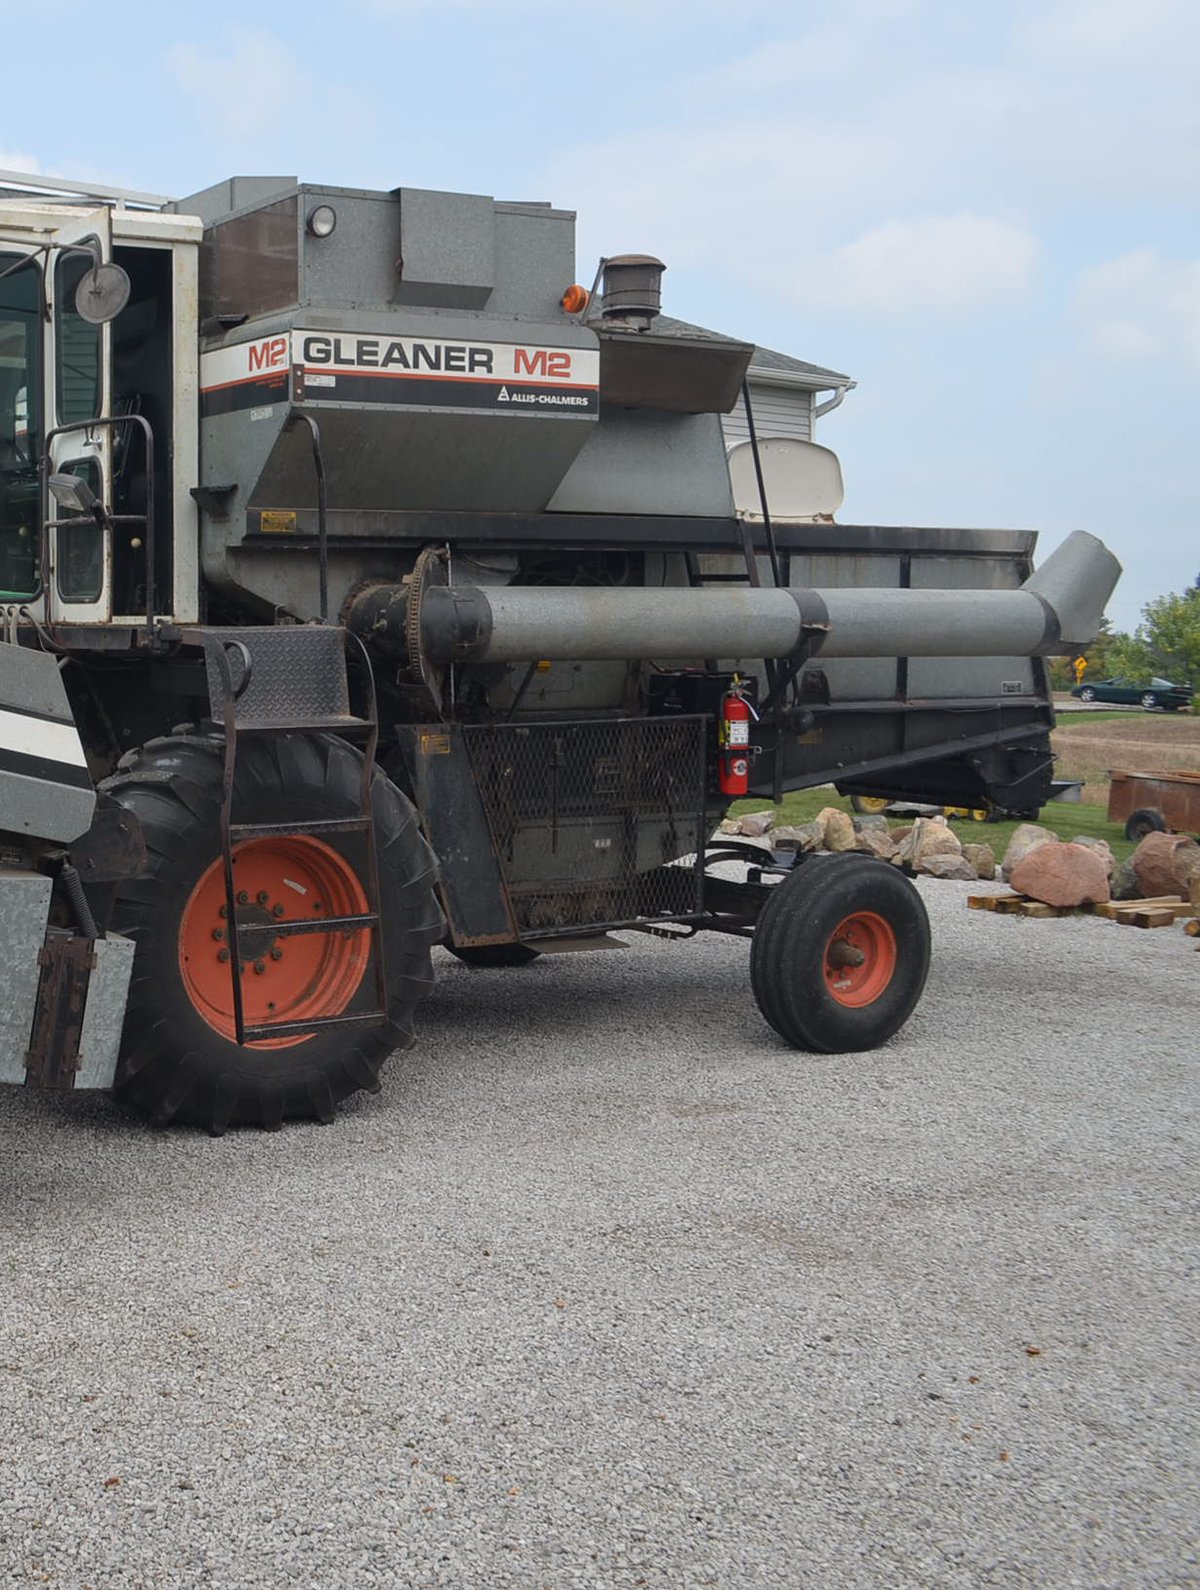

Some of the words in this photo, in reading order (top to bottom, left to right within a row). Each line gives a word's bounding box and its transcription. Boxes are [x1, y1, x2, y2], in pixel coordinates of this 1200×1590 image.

[248, 338, 287, 371] M2
[303, 336, 494, 374] GLEANER
[514, 348, 571, 378] M2
[511, 393, 589, 406] ALLIS-CHALMERS
